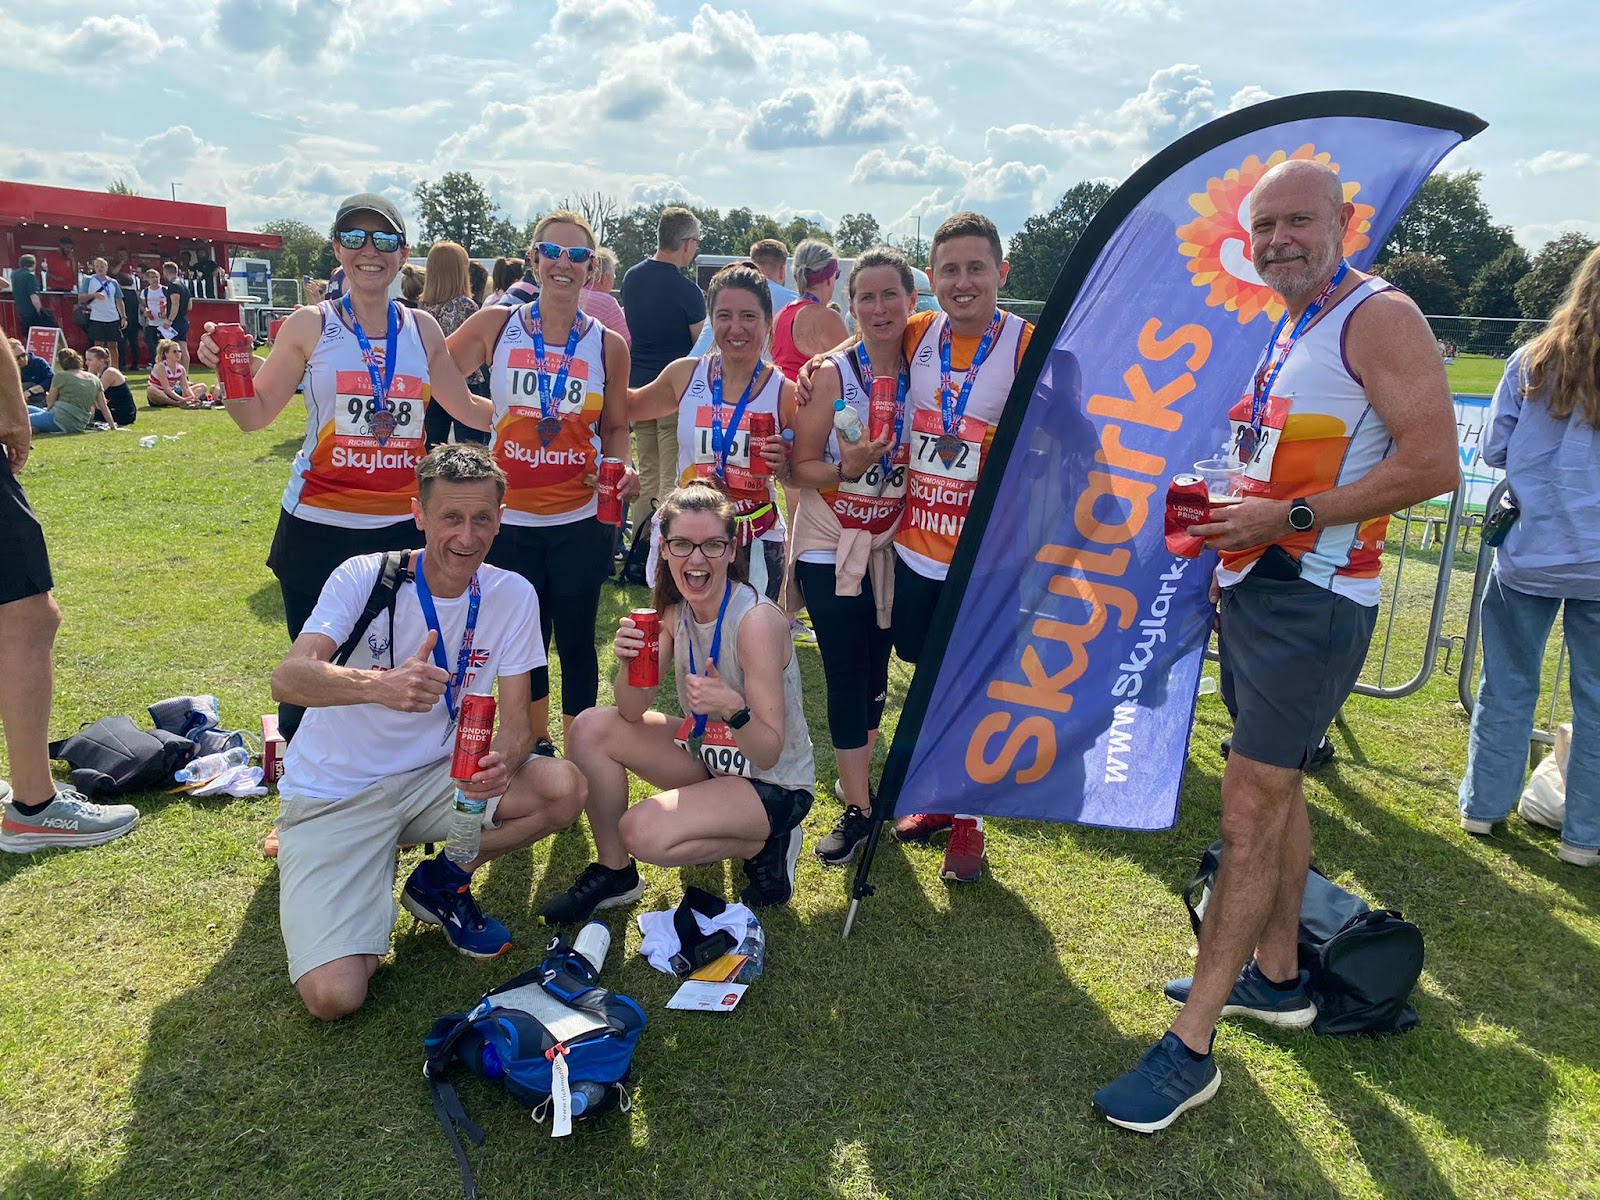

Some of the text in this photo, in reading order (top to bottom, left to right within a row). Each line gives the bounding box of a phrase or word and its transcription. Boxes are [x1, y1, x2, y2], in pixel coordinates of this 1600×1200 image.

[348, 439, 389, 447] RICHMOD
[503, 440, 587, 469] Skylarks
[917, 435, 970, 469] 772
[331, 446, 422, 474] Skylarks
[1173, 504, 1205, 517] LONDON
[1177, 511, 1200, 522] PRIDE
[965, 317, 1212, 784] Skylarks
[459, 726, 491, 735] LONDON
[462, 733, 487, 742] PRIDE
[41, 817, 79, 831] HOKA
